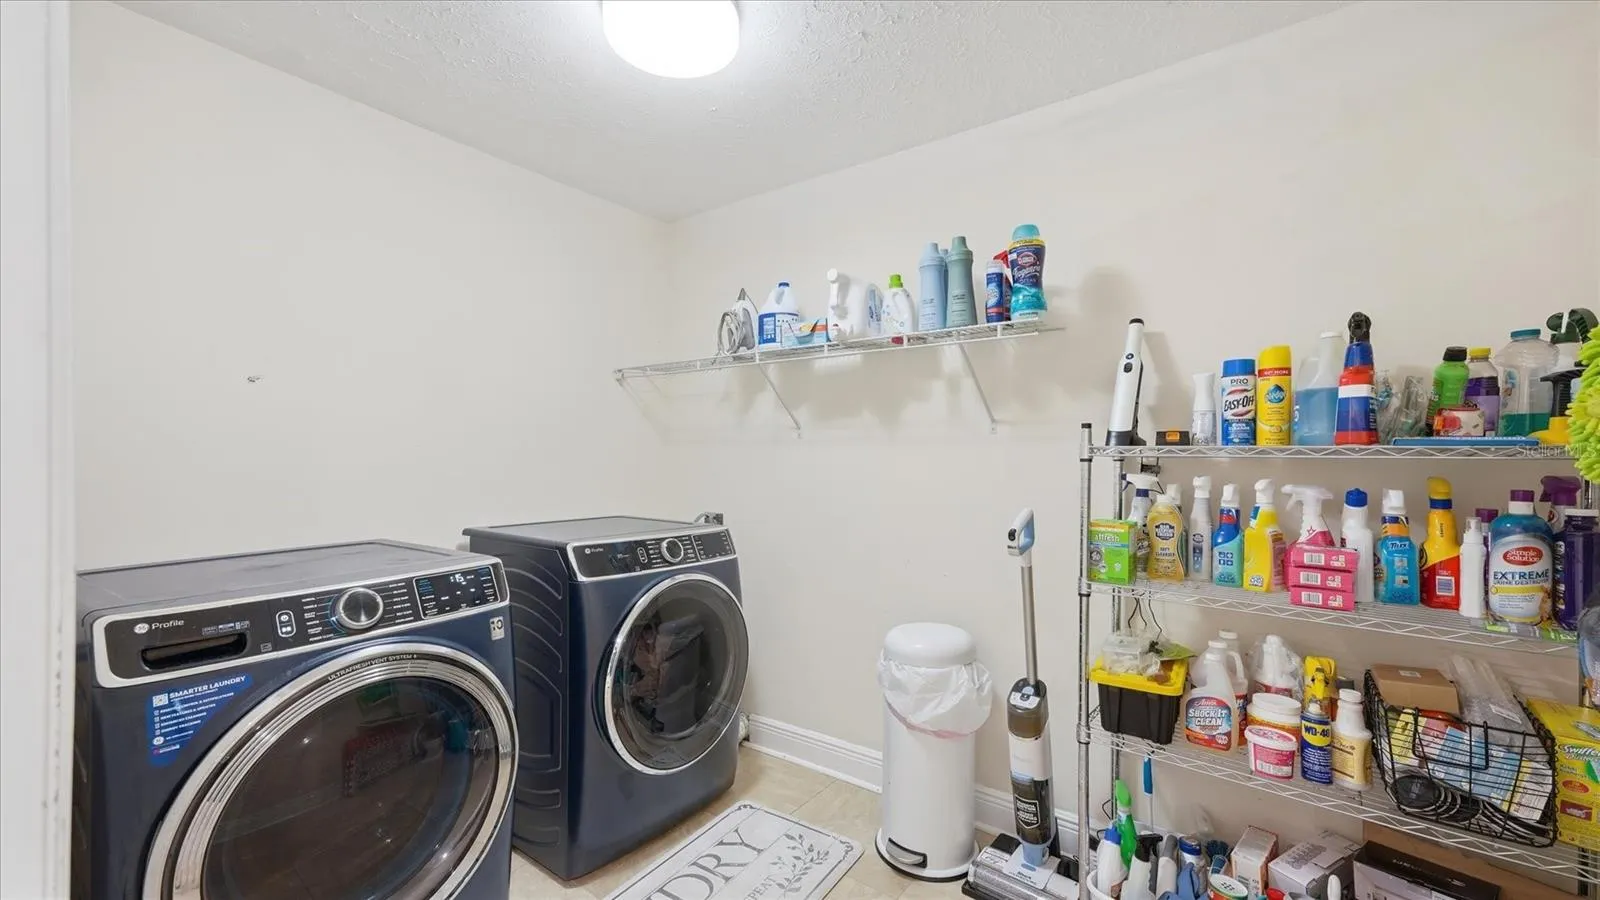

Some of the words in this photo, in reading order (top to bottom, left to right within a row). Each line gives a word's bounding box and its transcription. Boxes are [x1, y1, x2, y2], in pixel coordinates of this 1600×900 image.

[1493, 569, 1550, 580] EXTREME
[151, 619, 185, 630] Profile
[328, 661, 371, 681] ULTRAFRESH
[371, 656, 388, 665] VENT
[388, 653, 412, 661] SYSTEM
[169, 684, 209, 699] SMARTER
[209, 675, 246, 689] LAUNDRY
[1195, 717, 1223, 726] CLEAN
[645, 827, 764, 900] DRY
